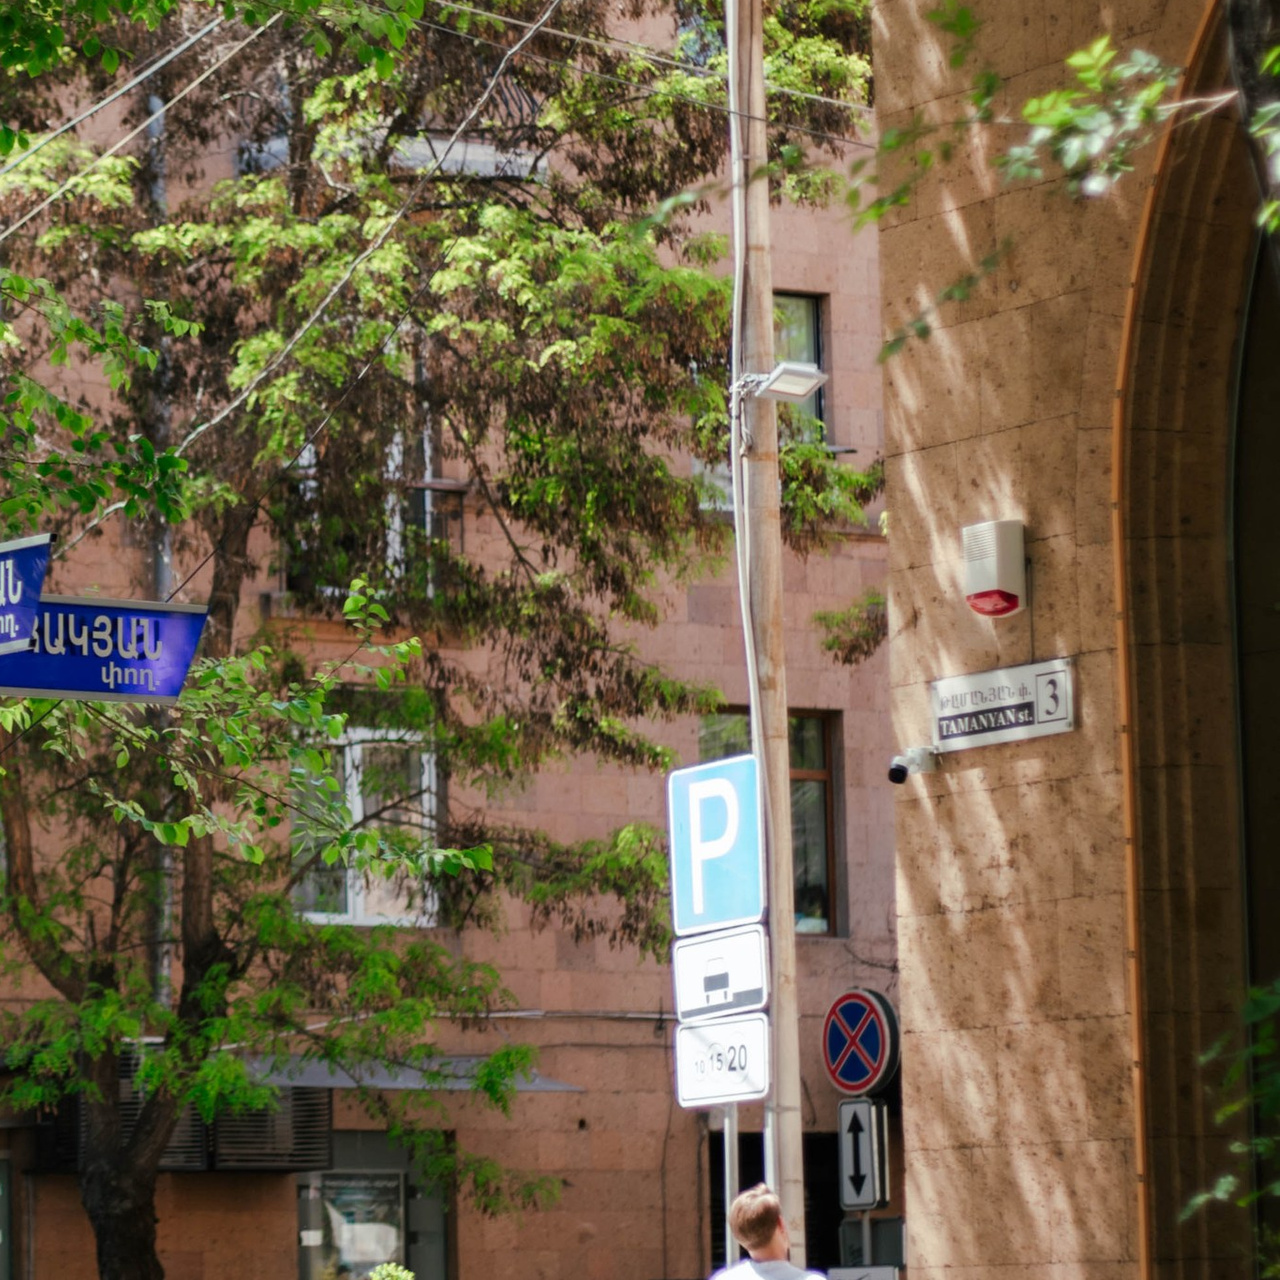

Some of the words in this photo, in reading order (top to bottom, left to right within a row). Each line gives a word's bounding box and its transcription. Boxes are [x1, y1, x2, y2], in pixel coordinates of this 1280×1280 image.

[102, 661, 161, 692] փող.
[1045, 678, 1060, 716] 3
[939, 708, 1017, 737] TAMANYAN
[1019, 709, 1033, 724] st.
[688, 777, 740, 916] P
[694, 1059, 706, 1074] 10
[709, 1052, 723, 1072] 15
[727, 1044, 748, 1072] 20
